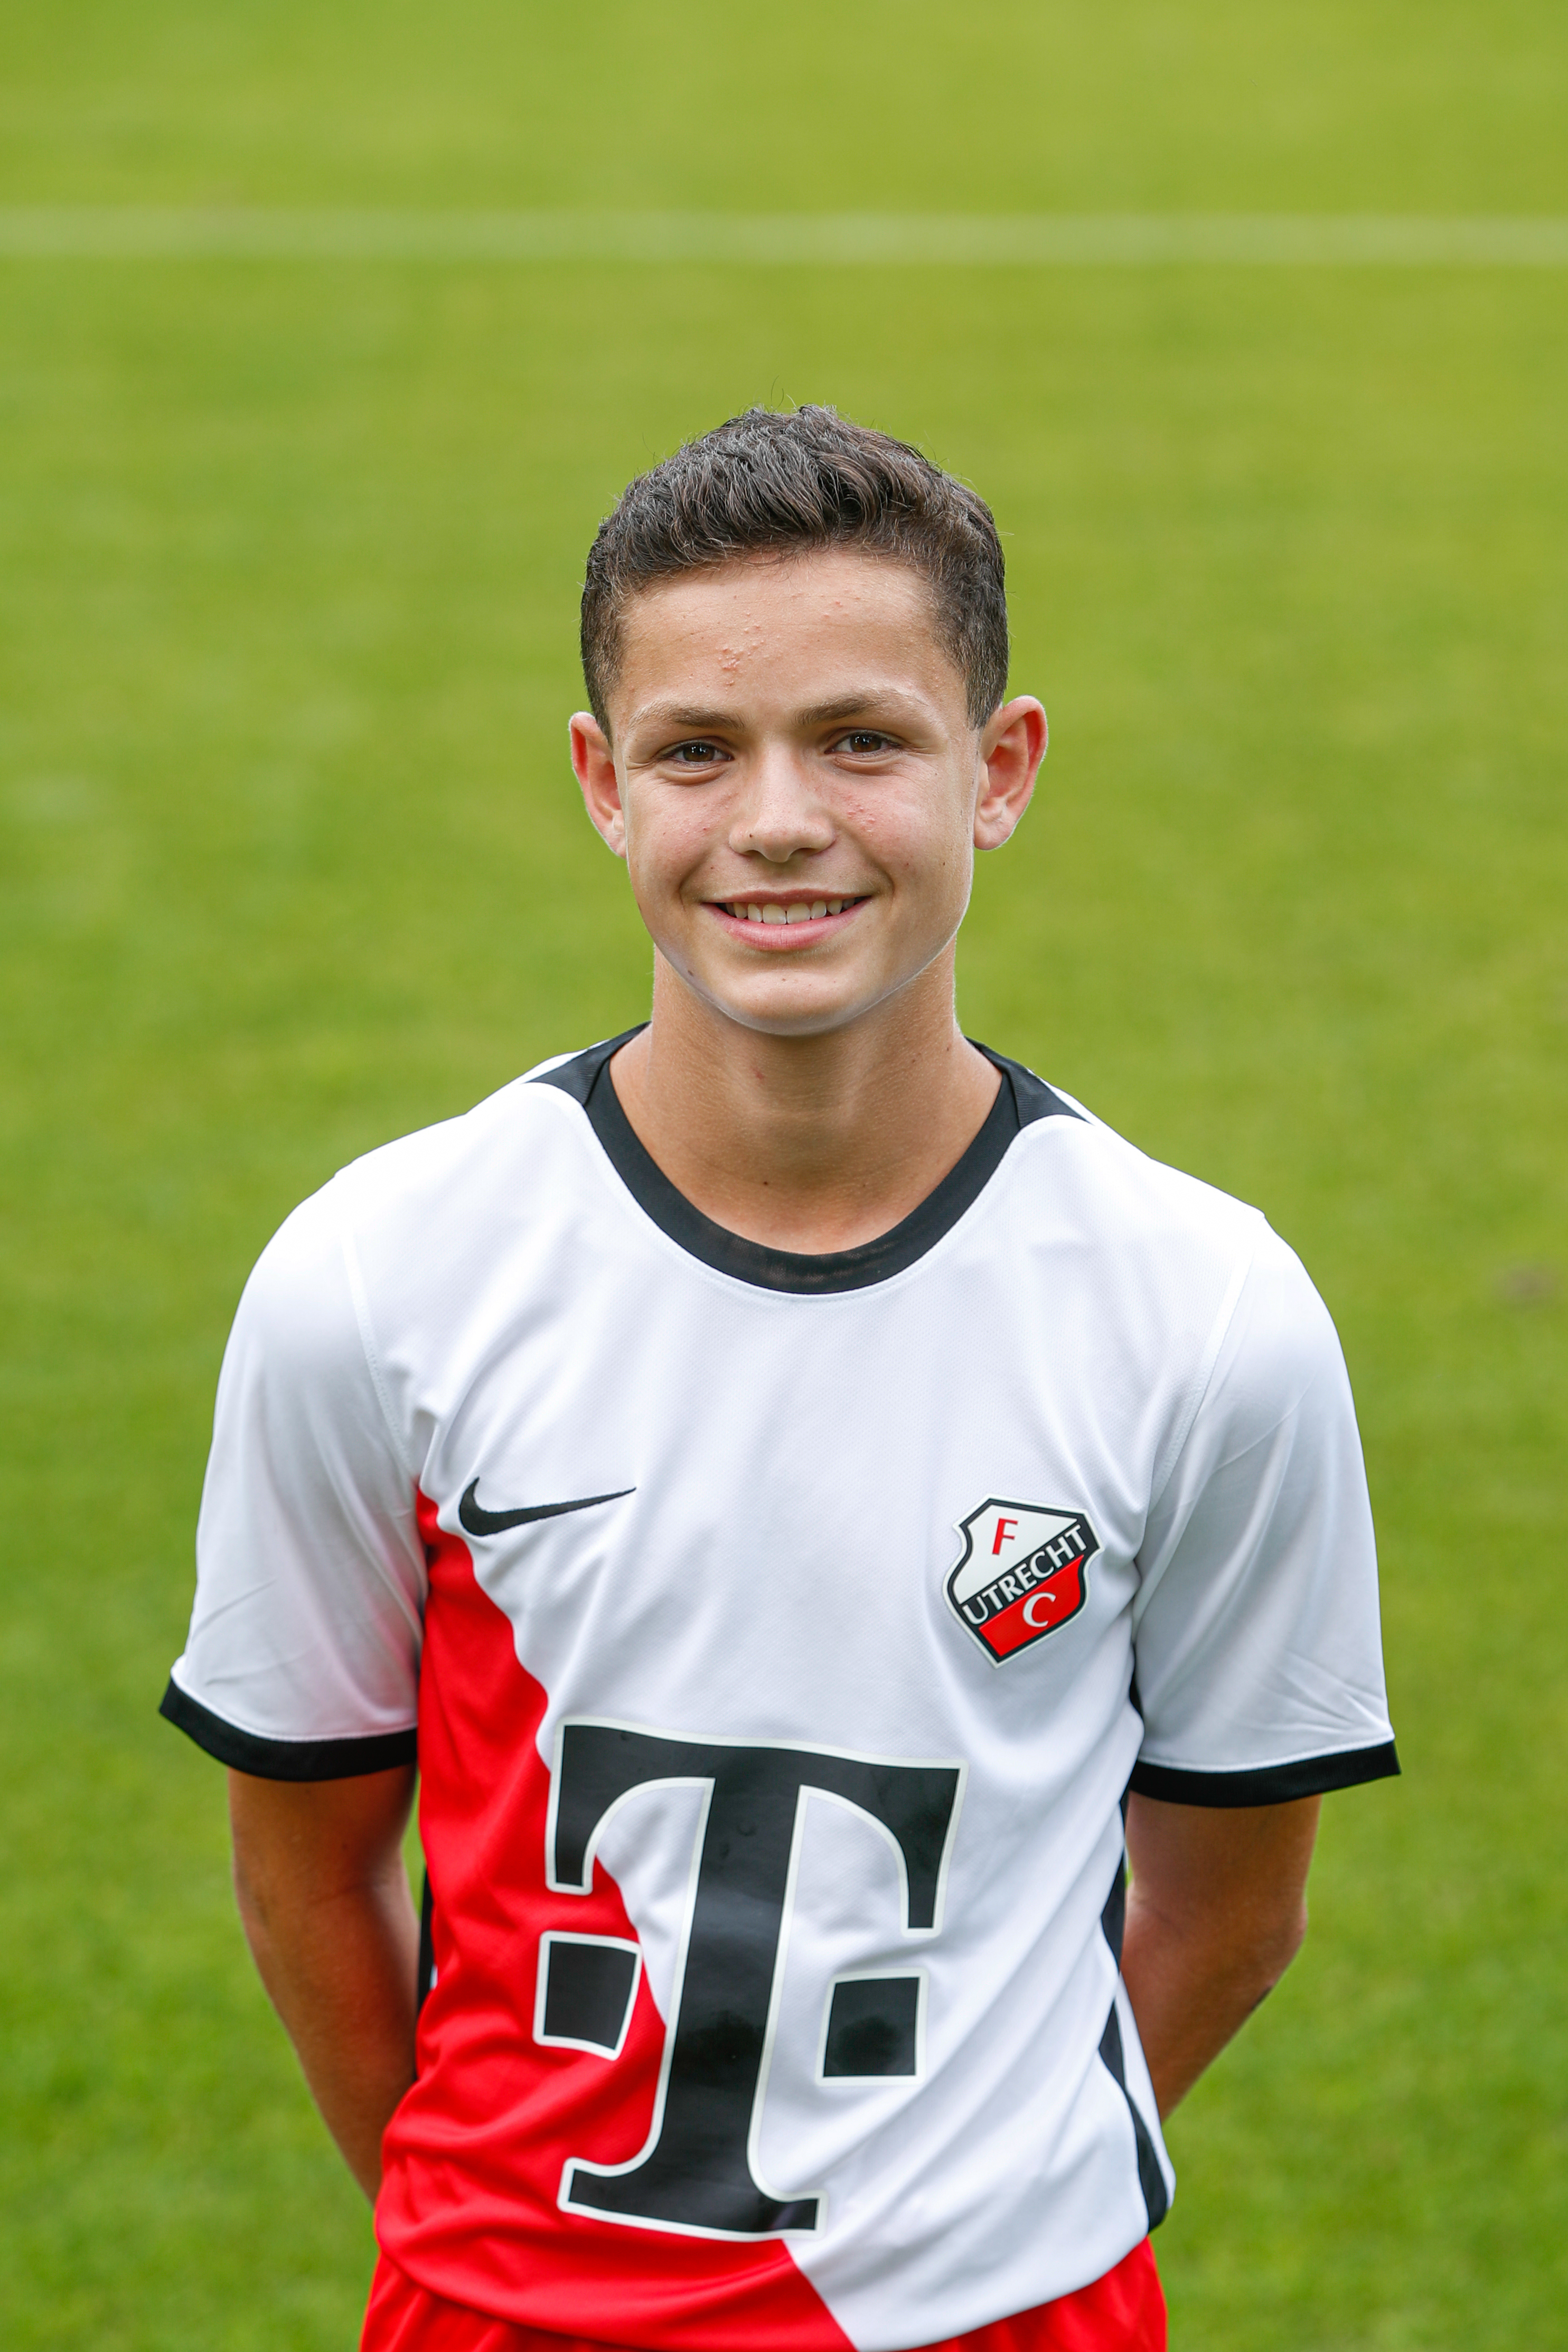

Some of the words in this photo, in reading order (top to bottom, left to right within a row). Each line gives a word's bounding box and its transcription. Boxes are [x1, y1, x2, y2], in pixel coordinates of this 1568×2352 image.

[991, 1517, 1019, 1555] F
[961, 1523, 1087, 1625] UTRECHT
[1022, 1592, 1056, 1628] C
[546, 1716, 968, 2242] T
